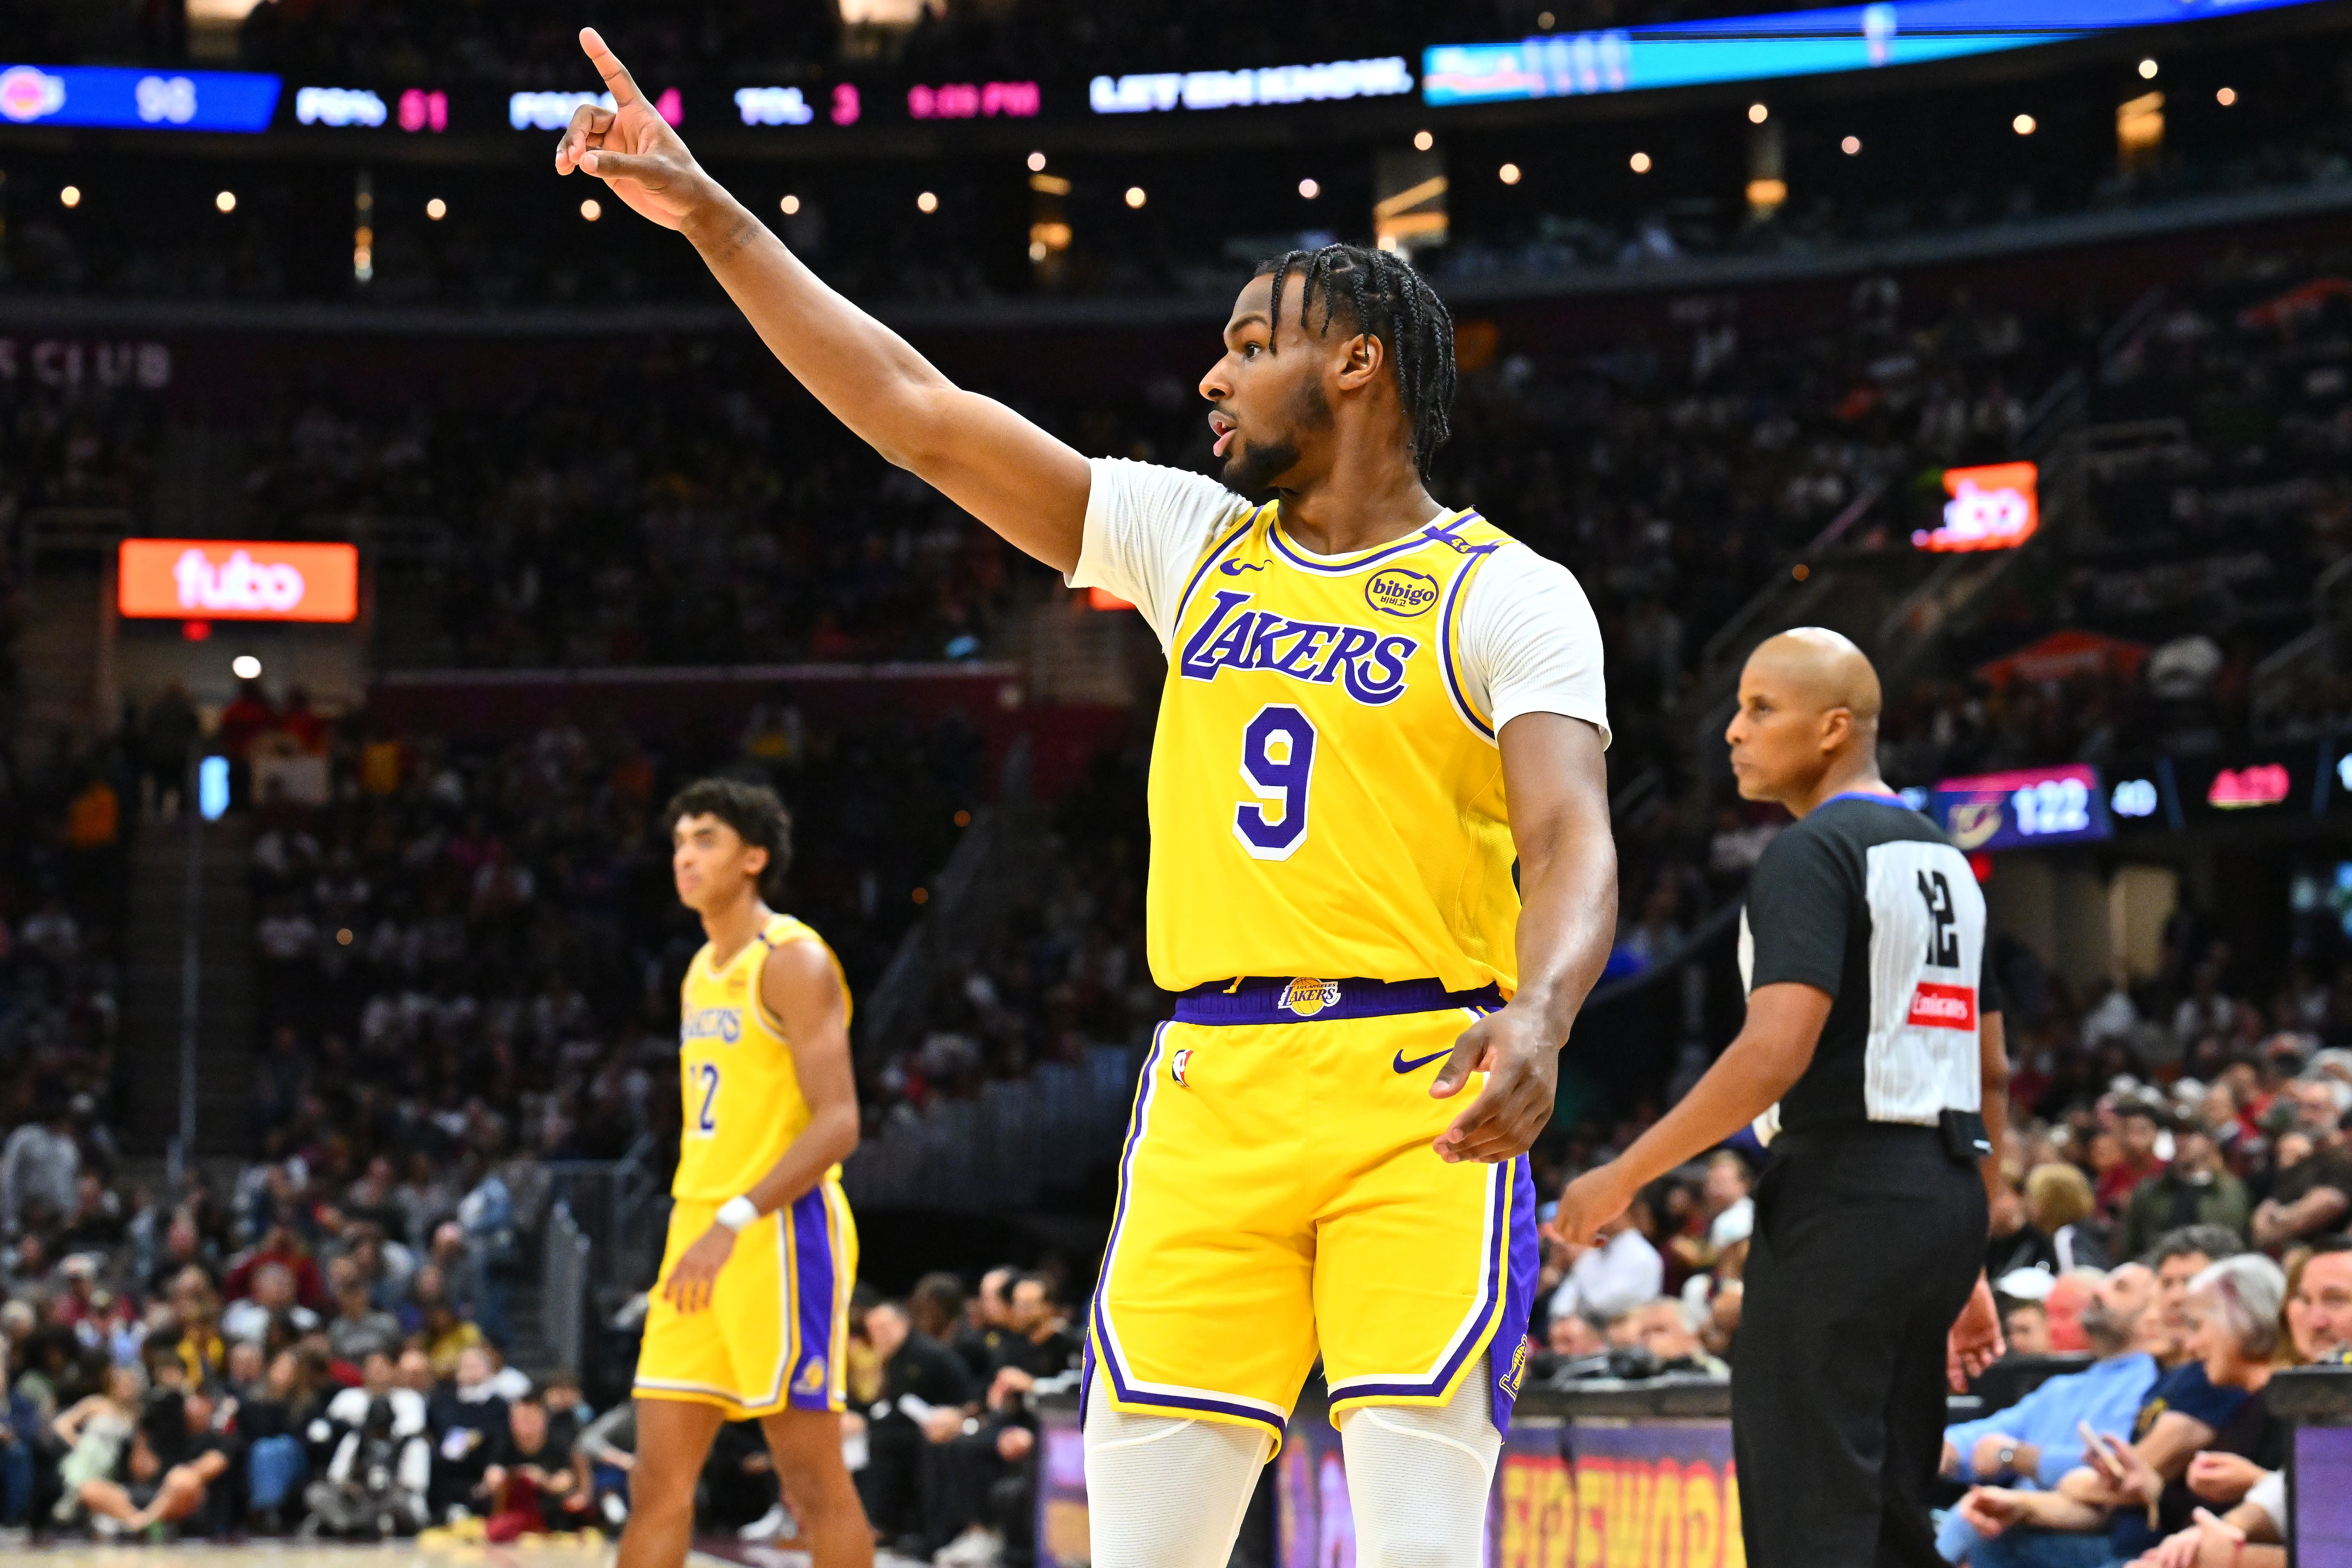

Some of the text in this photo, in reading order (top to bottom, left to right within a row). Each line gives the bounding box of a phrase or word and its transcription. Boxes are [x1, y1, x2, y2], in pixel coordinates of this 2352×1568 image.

[830, 83, 860, 126] 3
[1089, 72, 1180, 113] LET
[32, 340, 171, 389] CLUB
[1451, 538, 1472, 553] 44
[173, 548, 305, 611] fubo
[1373, 578, 1434, 605] bibigo
[1380, 596, 1406, 607] 비비고
[1181, 589, 1421, 707] LAKERS
[1233, 704, 1317, 860] 9
[2012, 778, 2090, 835] 122
[1282, 986, 1338, 1006] LAKERS
